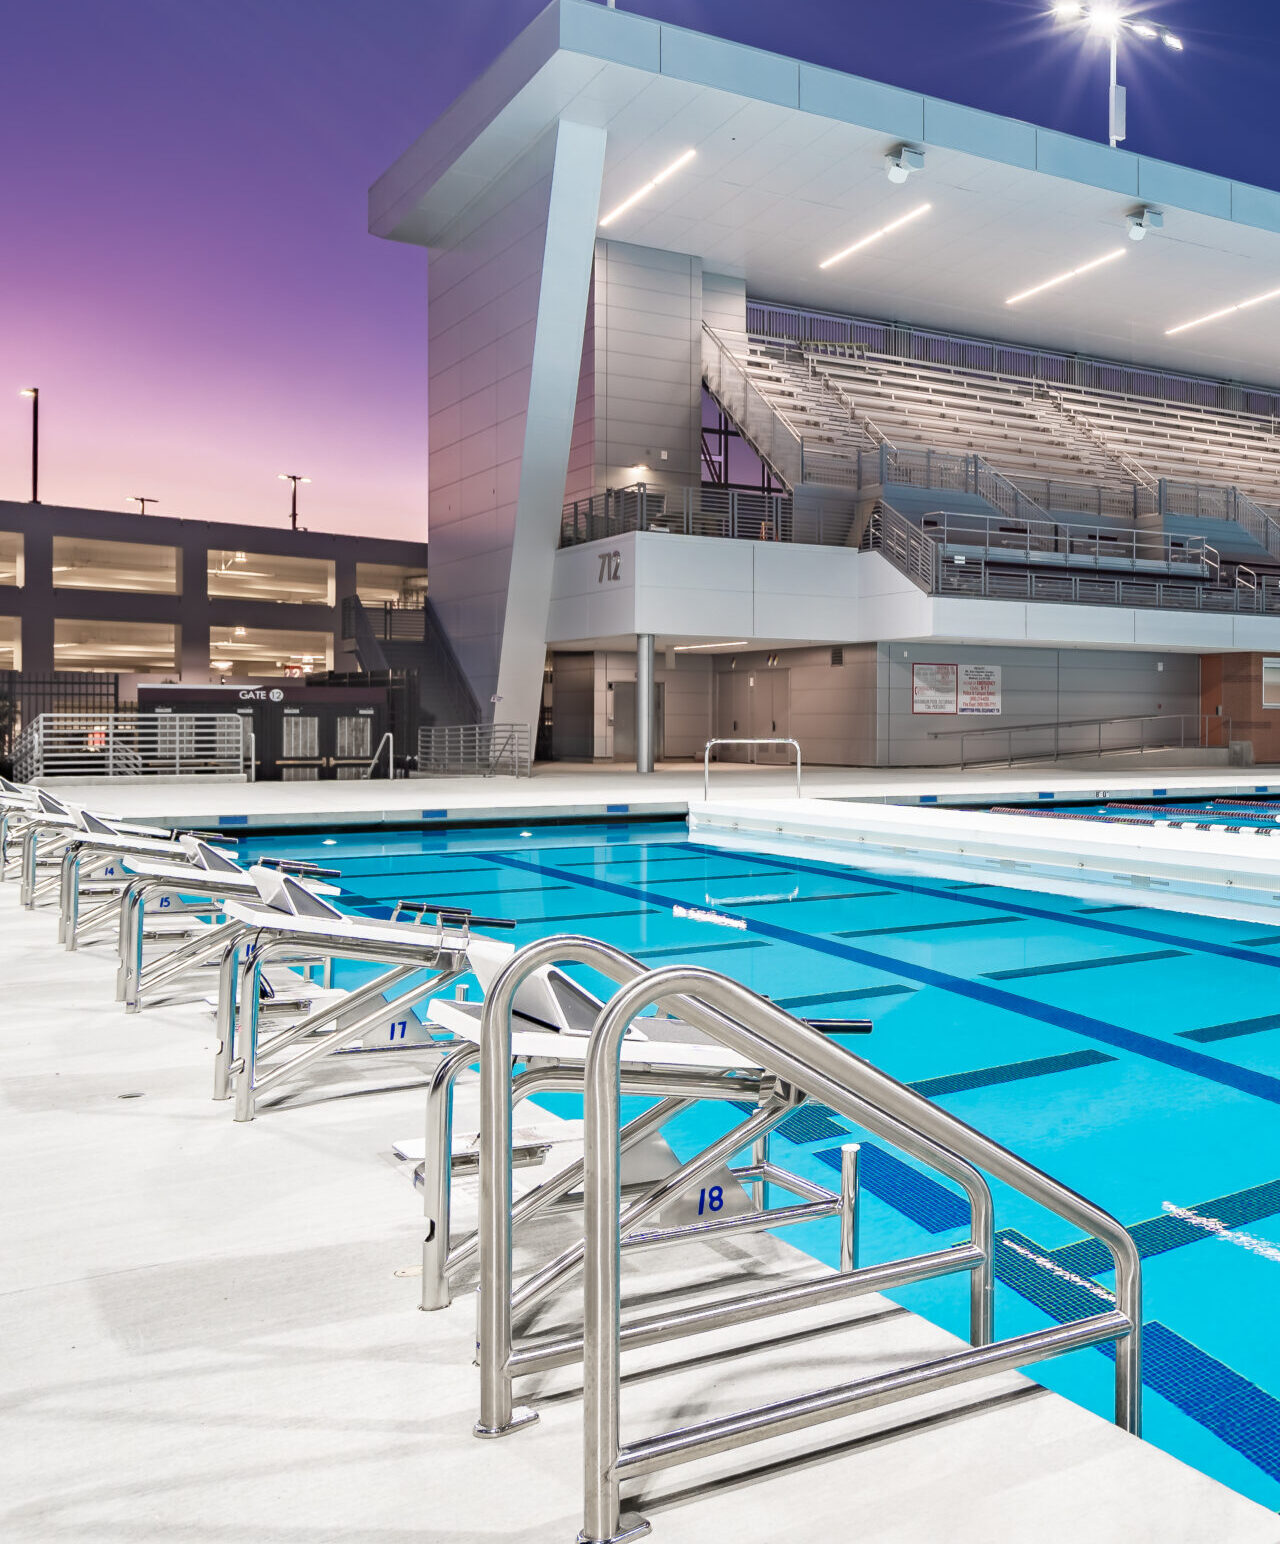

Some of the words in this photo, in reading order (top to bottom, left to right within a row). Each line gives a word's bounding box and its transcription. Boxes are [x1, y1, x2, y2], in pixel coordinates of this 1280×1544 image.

[598, 550, 621, 584] 712
[239, 691, 267, 699] GATE
[271, 690, 282, 699] 12
[105, 867, 115, 876] 14
[160, 897, 171, 908] 15
[390, 1021, 407, 1041] 17
[698, 1185, 724, 1216] 18
